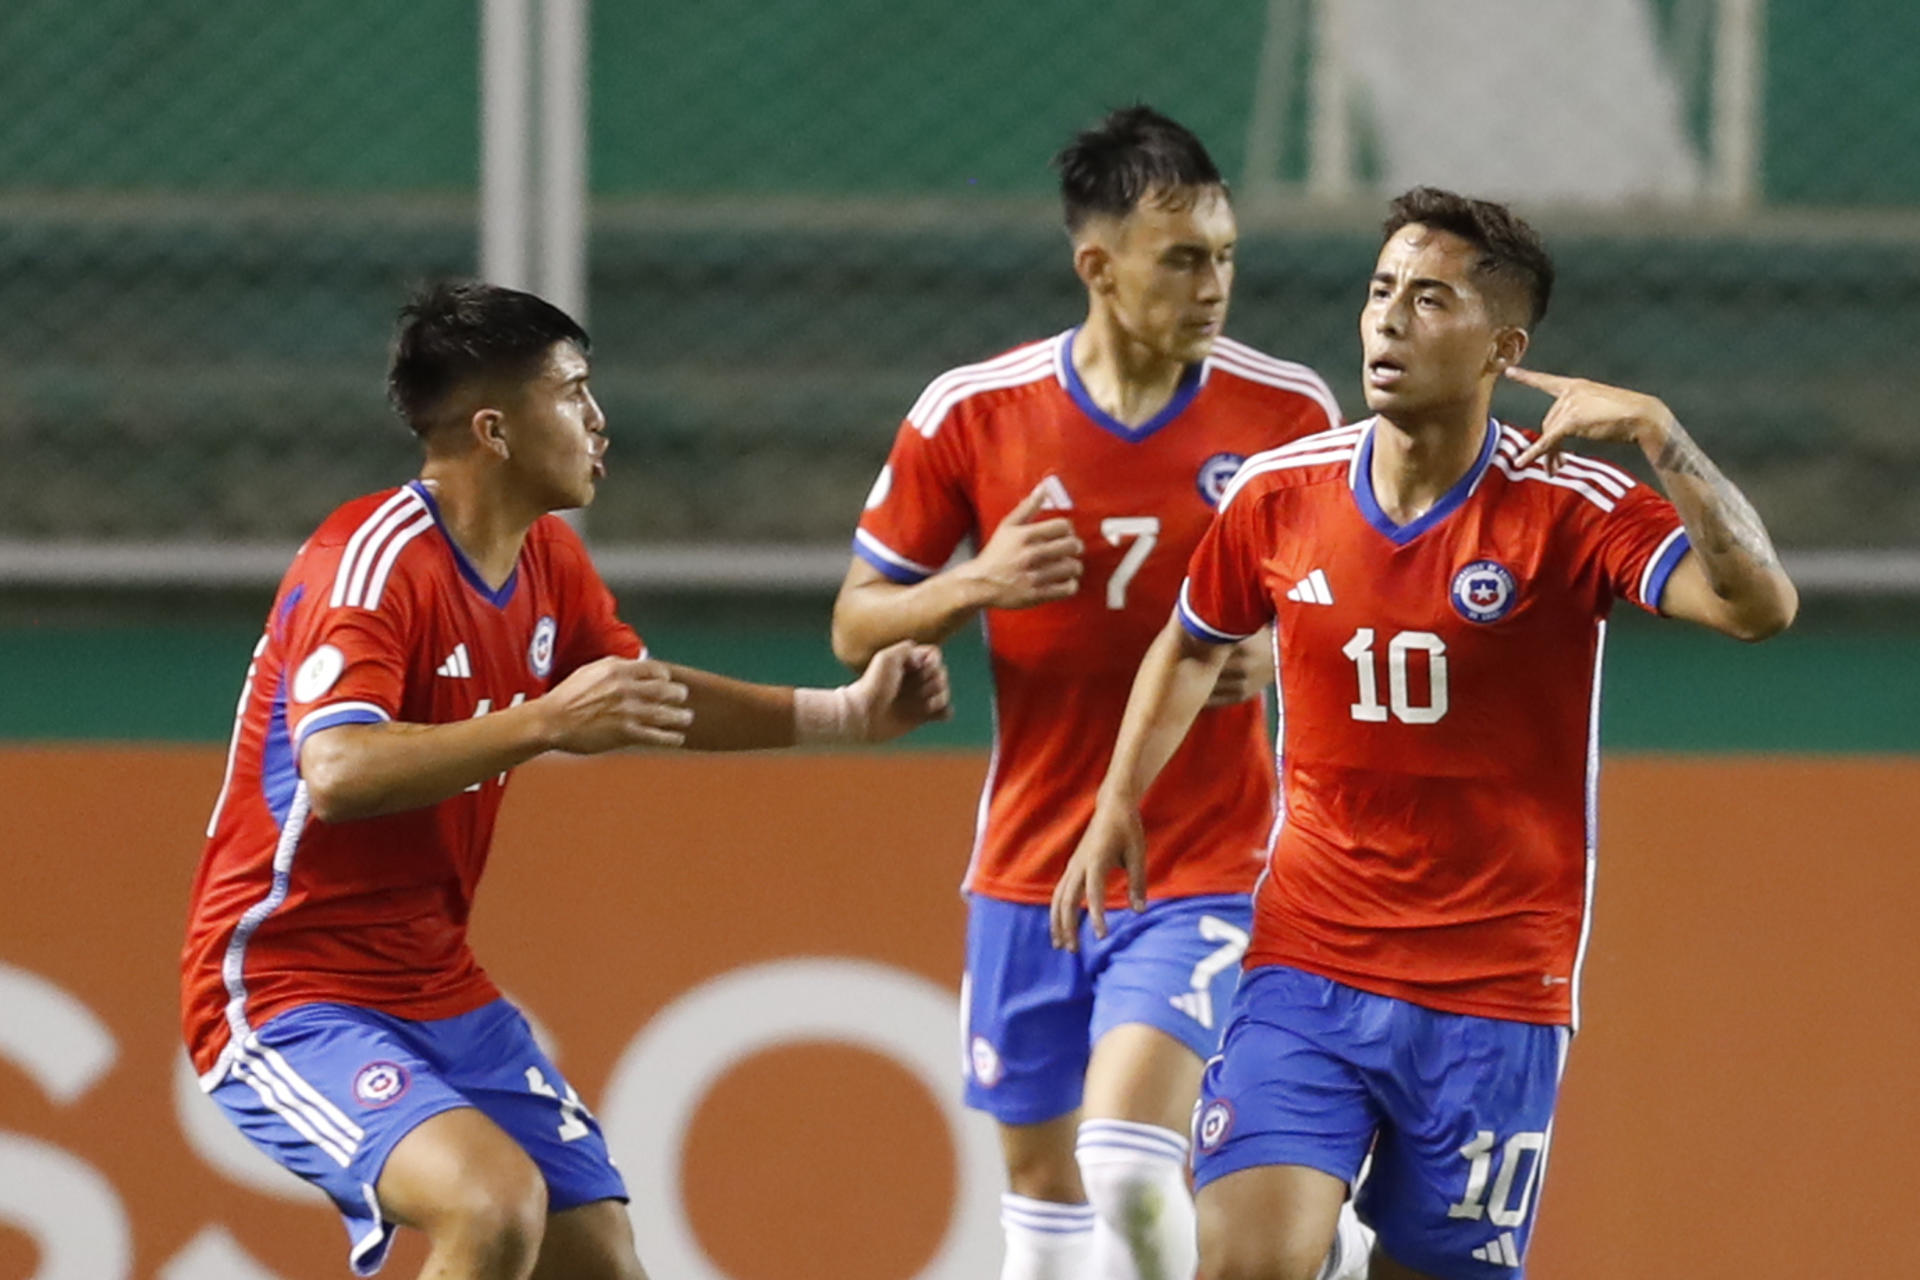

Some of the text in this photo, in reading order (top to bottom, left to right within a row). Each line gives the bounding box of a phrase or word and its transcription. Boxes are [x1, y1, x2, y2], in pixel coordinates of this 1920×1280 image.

[1101, 516, 1160, 610] 7
[1342, 627, 1449, 724] 10
[1190, 914, 1250, 990] 7
[1447, 1130, 1545, 1228] 10
